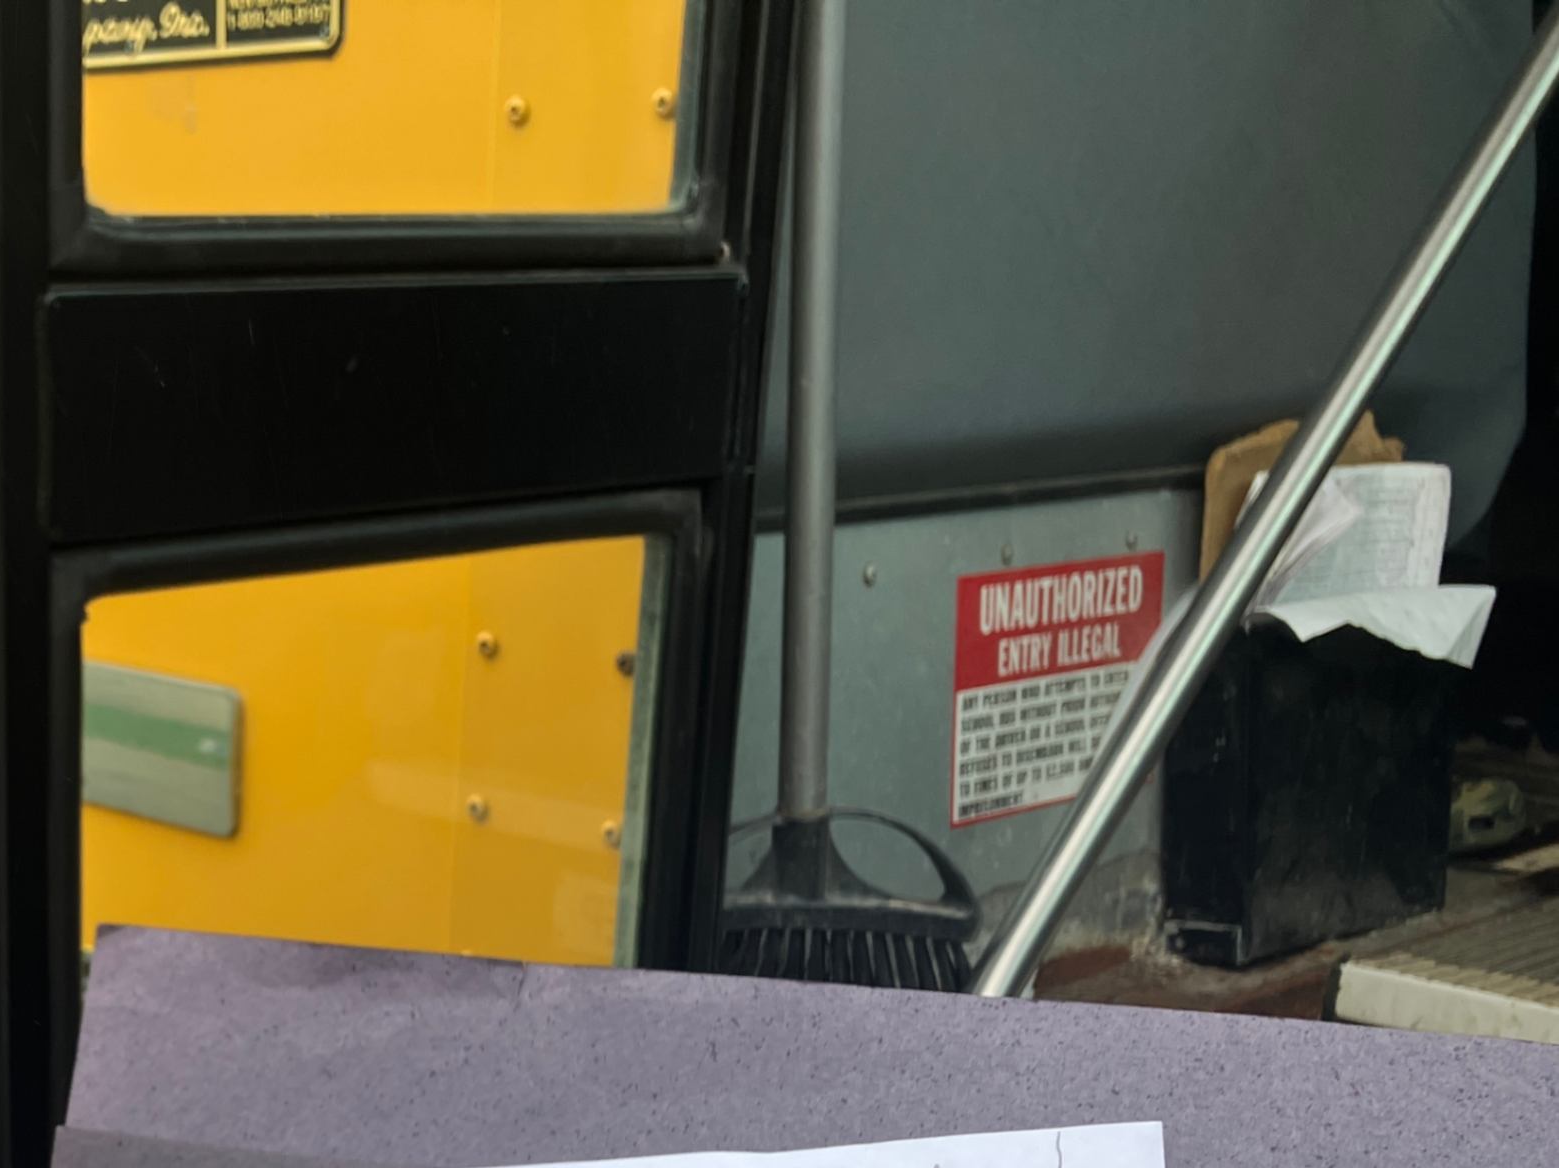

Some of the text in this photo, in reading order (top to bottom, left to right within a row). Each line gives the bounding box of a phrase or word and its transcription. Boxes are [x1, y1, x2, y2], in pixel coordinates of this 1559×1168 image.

[979, 564, 1143, 636] UNAUTHORIZED
[998, 621, 1121, 678] ENTRY ILLEGAL
